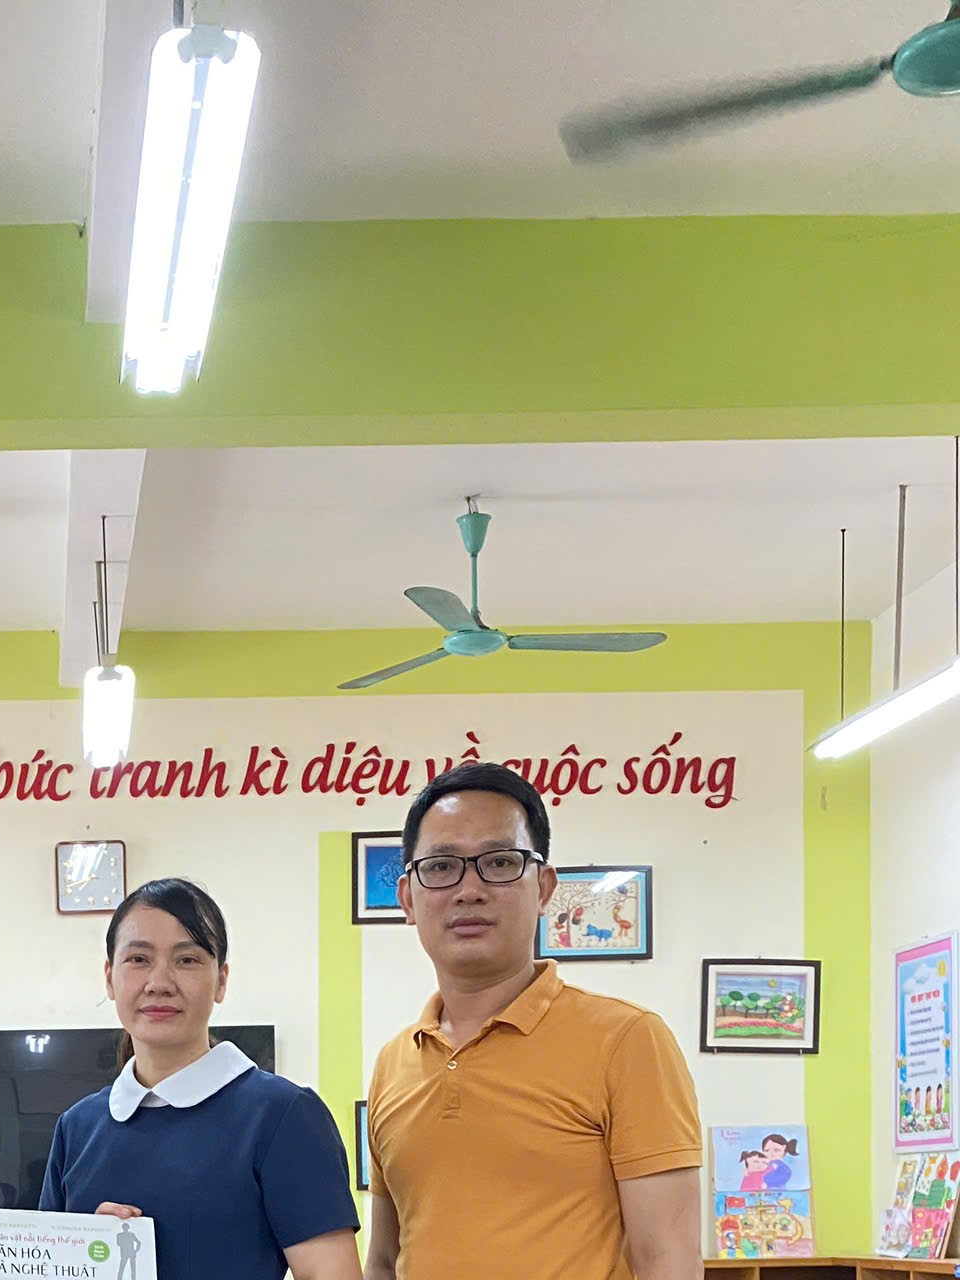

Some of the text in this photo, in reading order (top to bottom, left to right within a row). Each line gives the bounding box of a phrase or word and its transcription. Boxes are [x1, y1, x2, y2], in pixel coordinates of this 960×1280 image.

[90, 748, 229, 799] tranh
[240, 745, 289, 796] kì
[301, 741, 412, 806] diệu
[617, 732, 737, 809] sống
[21, 1246, 51, 1260] HÓA
[11, 1262, 48, 1278] NGHỆ
[53, 1264, 97, 1280] THUẬT
